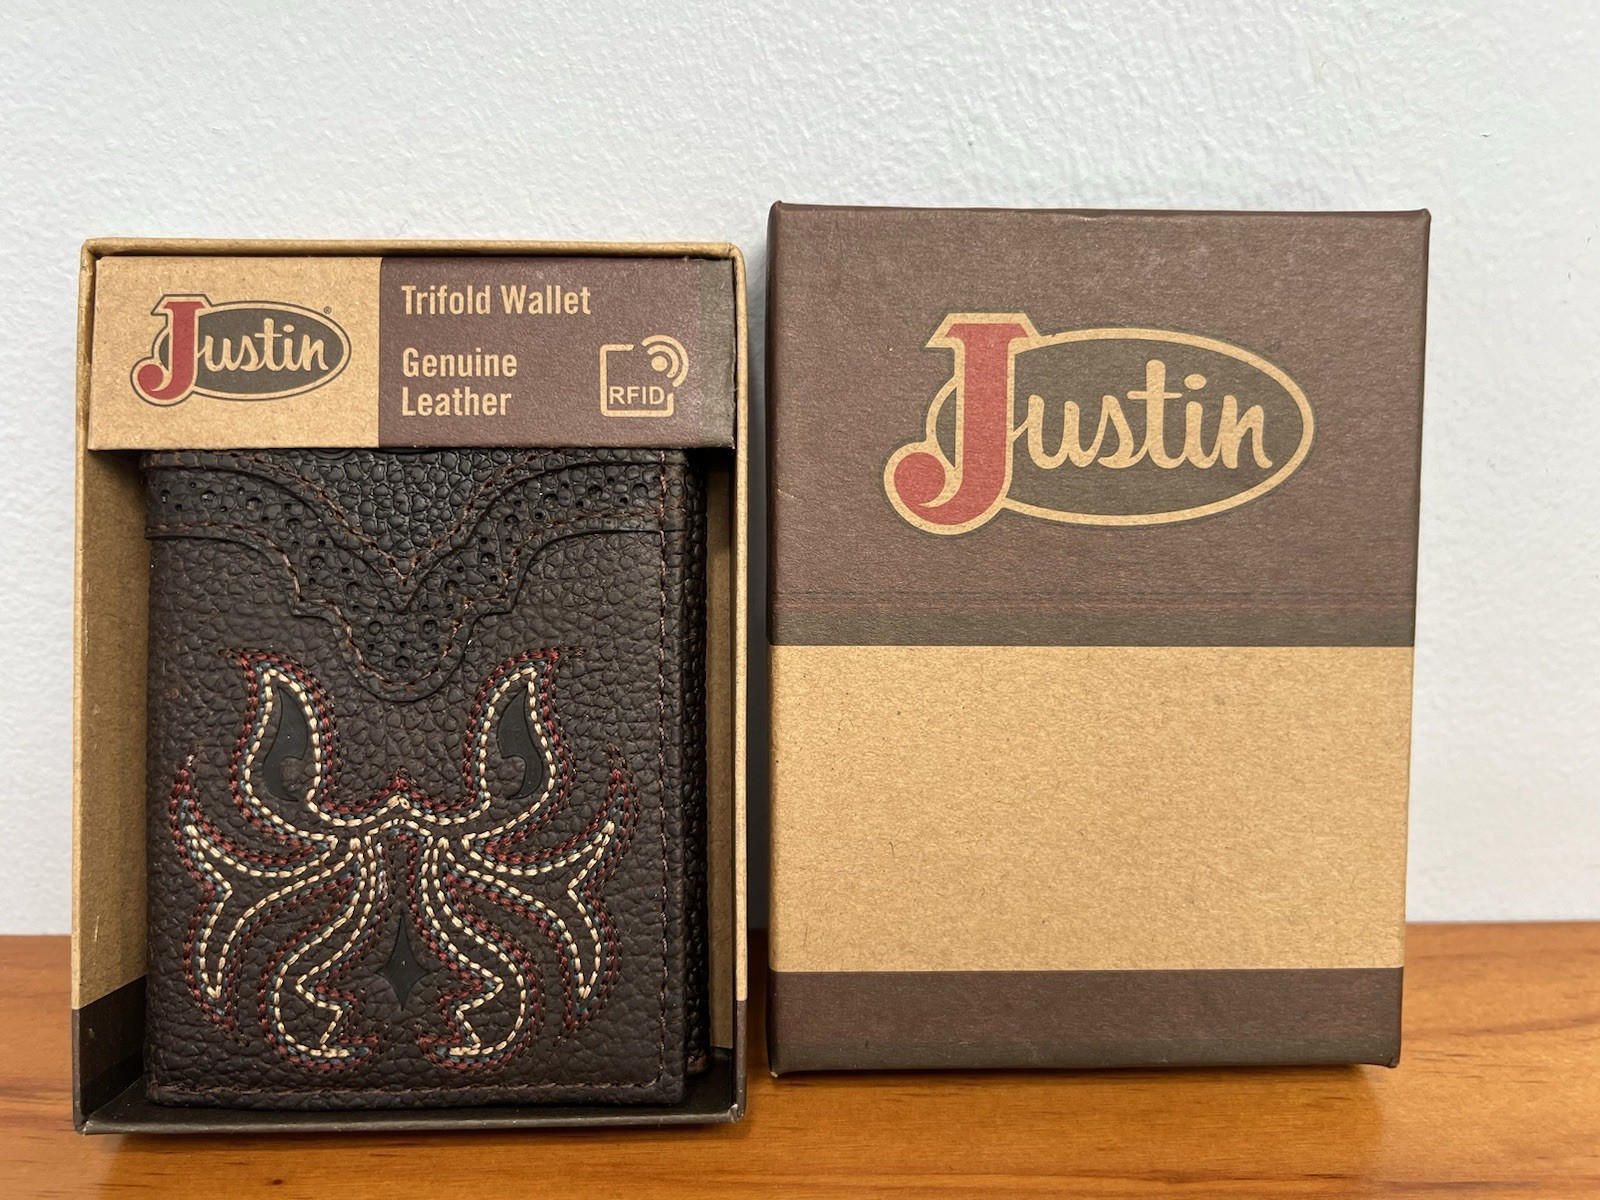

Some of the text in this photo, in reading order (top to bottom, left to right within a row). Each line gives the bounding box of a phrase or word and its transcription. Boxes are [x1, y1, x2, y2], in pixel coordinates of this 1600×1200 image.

[401, 285, 591, 315] Trifold Wallet
[133, 296, 330, 405] Justin
[402, 347, 518, 377] Genuine
[402, 387, 512, 416] Leather
[609, 386, 665, 405] RFID
[885, 314, 1274, 534] Justin
